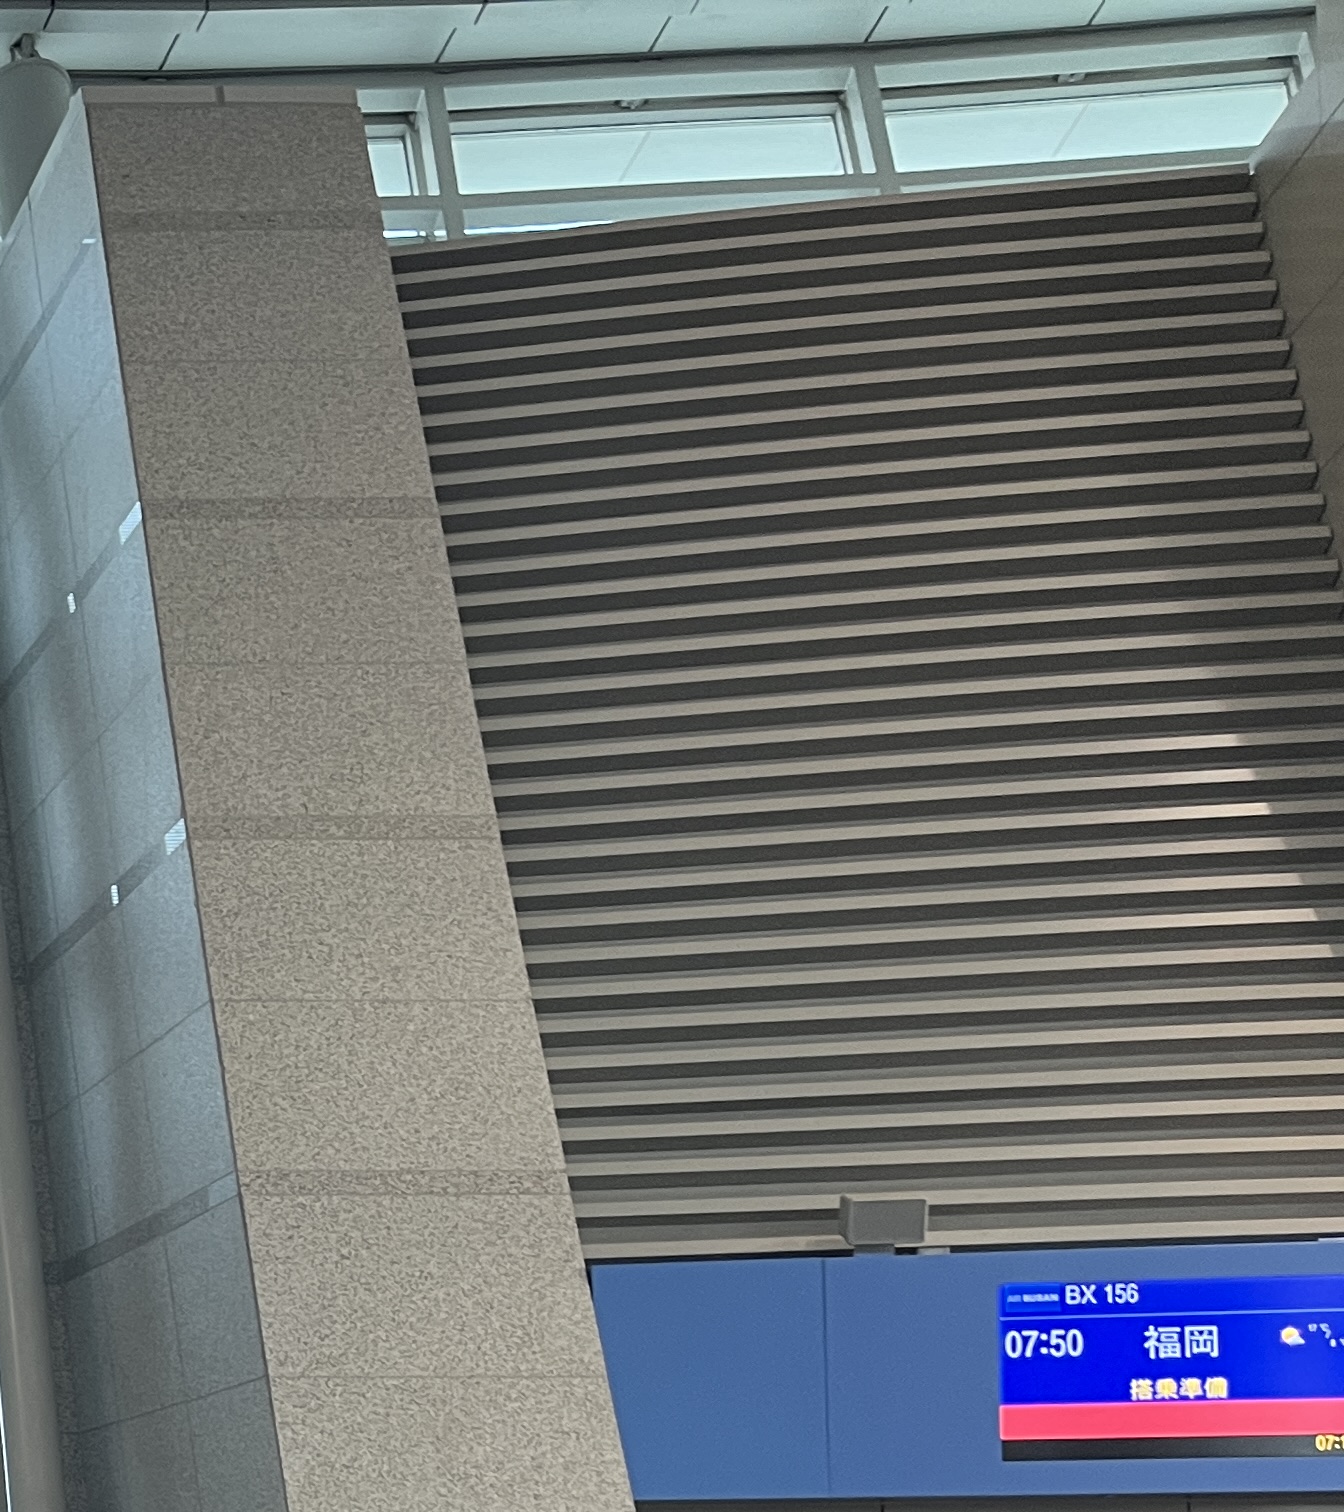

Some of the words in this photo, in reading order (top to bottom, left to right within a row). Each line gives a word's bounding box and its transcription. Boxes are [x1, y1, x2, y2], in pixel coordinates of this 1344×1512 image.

[1065, 1284, 1097, 1305] BX
[1104, 1283, 1139, 1305] 156
[1004, 1329, 1084, 1359] 07:50
[1144, 1325, 1220, 1359] 福岡
